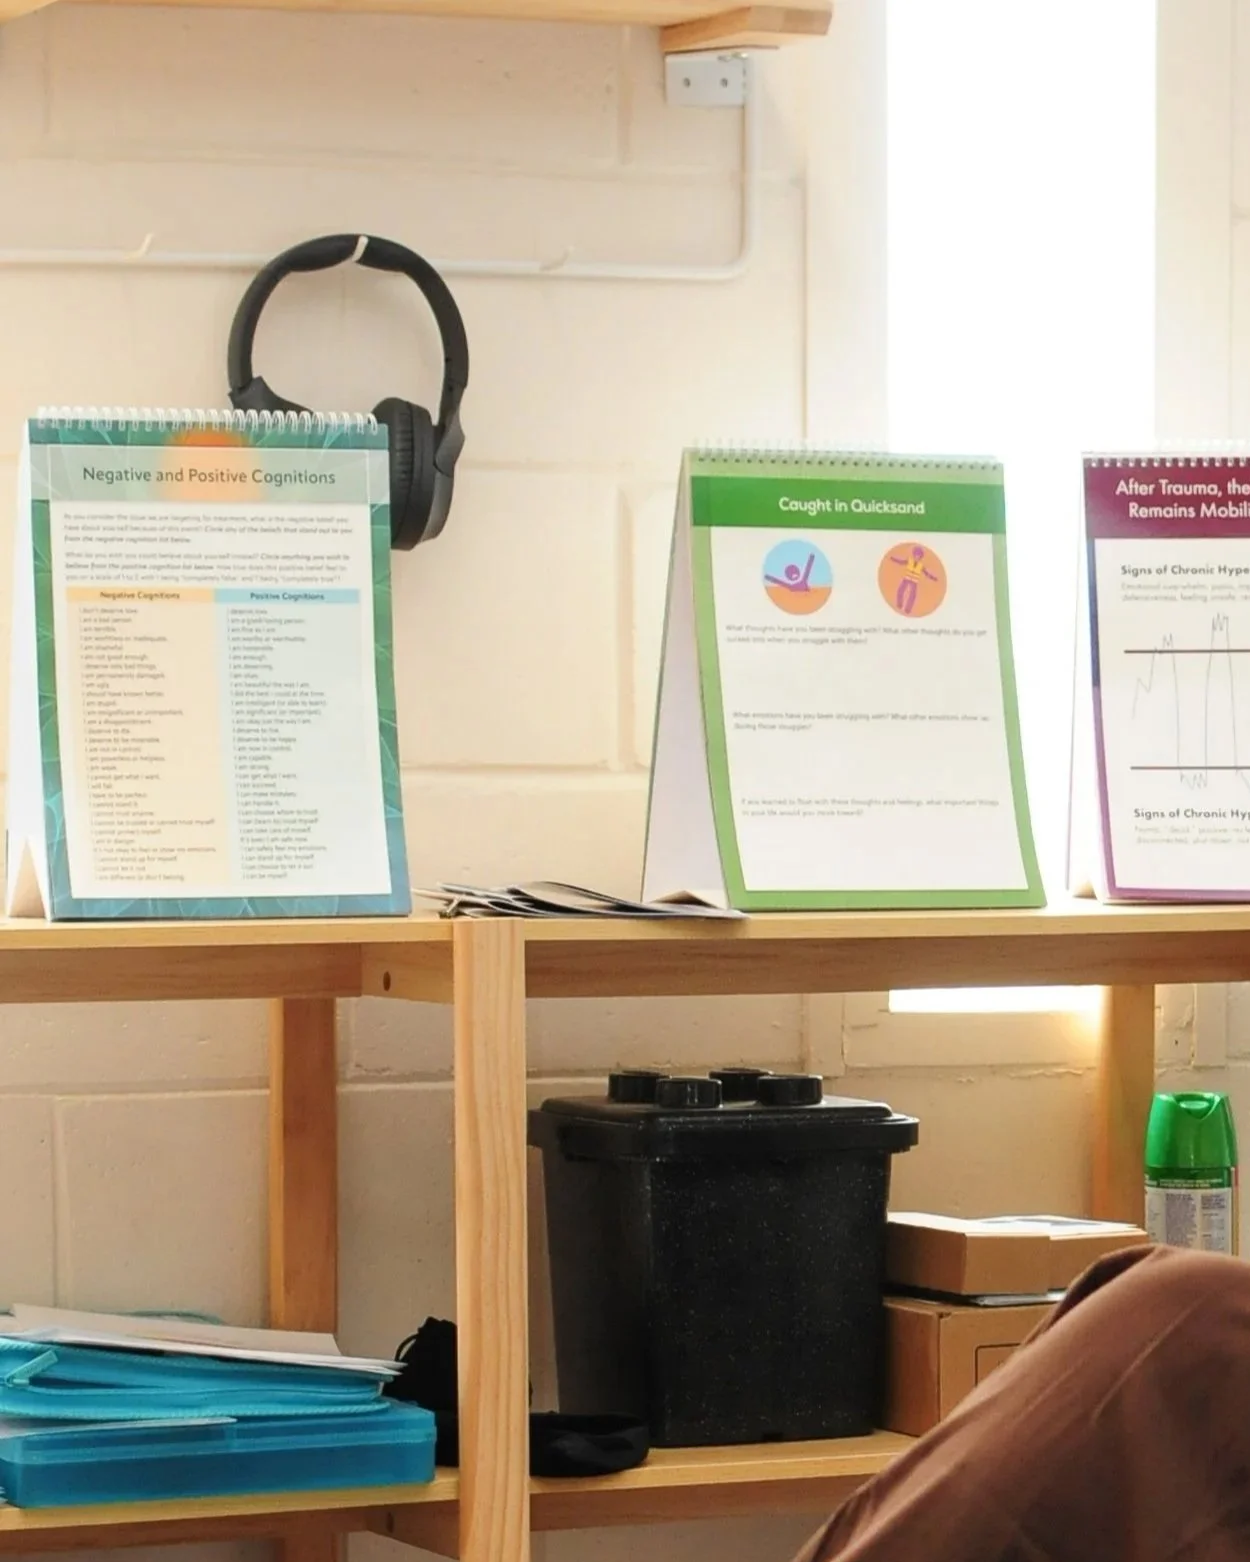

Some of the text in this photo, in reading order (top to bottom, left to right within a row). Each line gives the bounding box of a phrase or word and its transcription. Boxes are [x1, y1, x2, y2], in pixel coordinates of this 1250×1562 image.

[82, 467, 335, 486] Negative and Positive Cognitions
[1116, 478, 1155, 495] After
[1159, 479, 1222, 497] Trauma,
[1227, 478, 1250, 495] the
[778, 497, 925, 515] Caught in Quicksand
[1129, 502, 1195, 518] Remains
[1121, 564, 1152, 577] Signs
[1156, 564, 1167, 574] of
[1170, 564, 1214, 574] Chronic
[100, 592, 180, 602] Negative Cognitions
[250, 592, 324, 602] Positive Cognitions
[1134, 808, 1165, 820] Signs
[1168, 808, 1180, 818] of
[1184, 808, 1227, 818] Chronic
